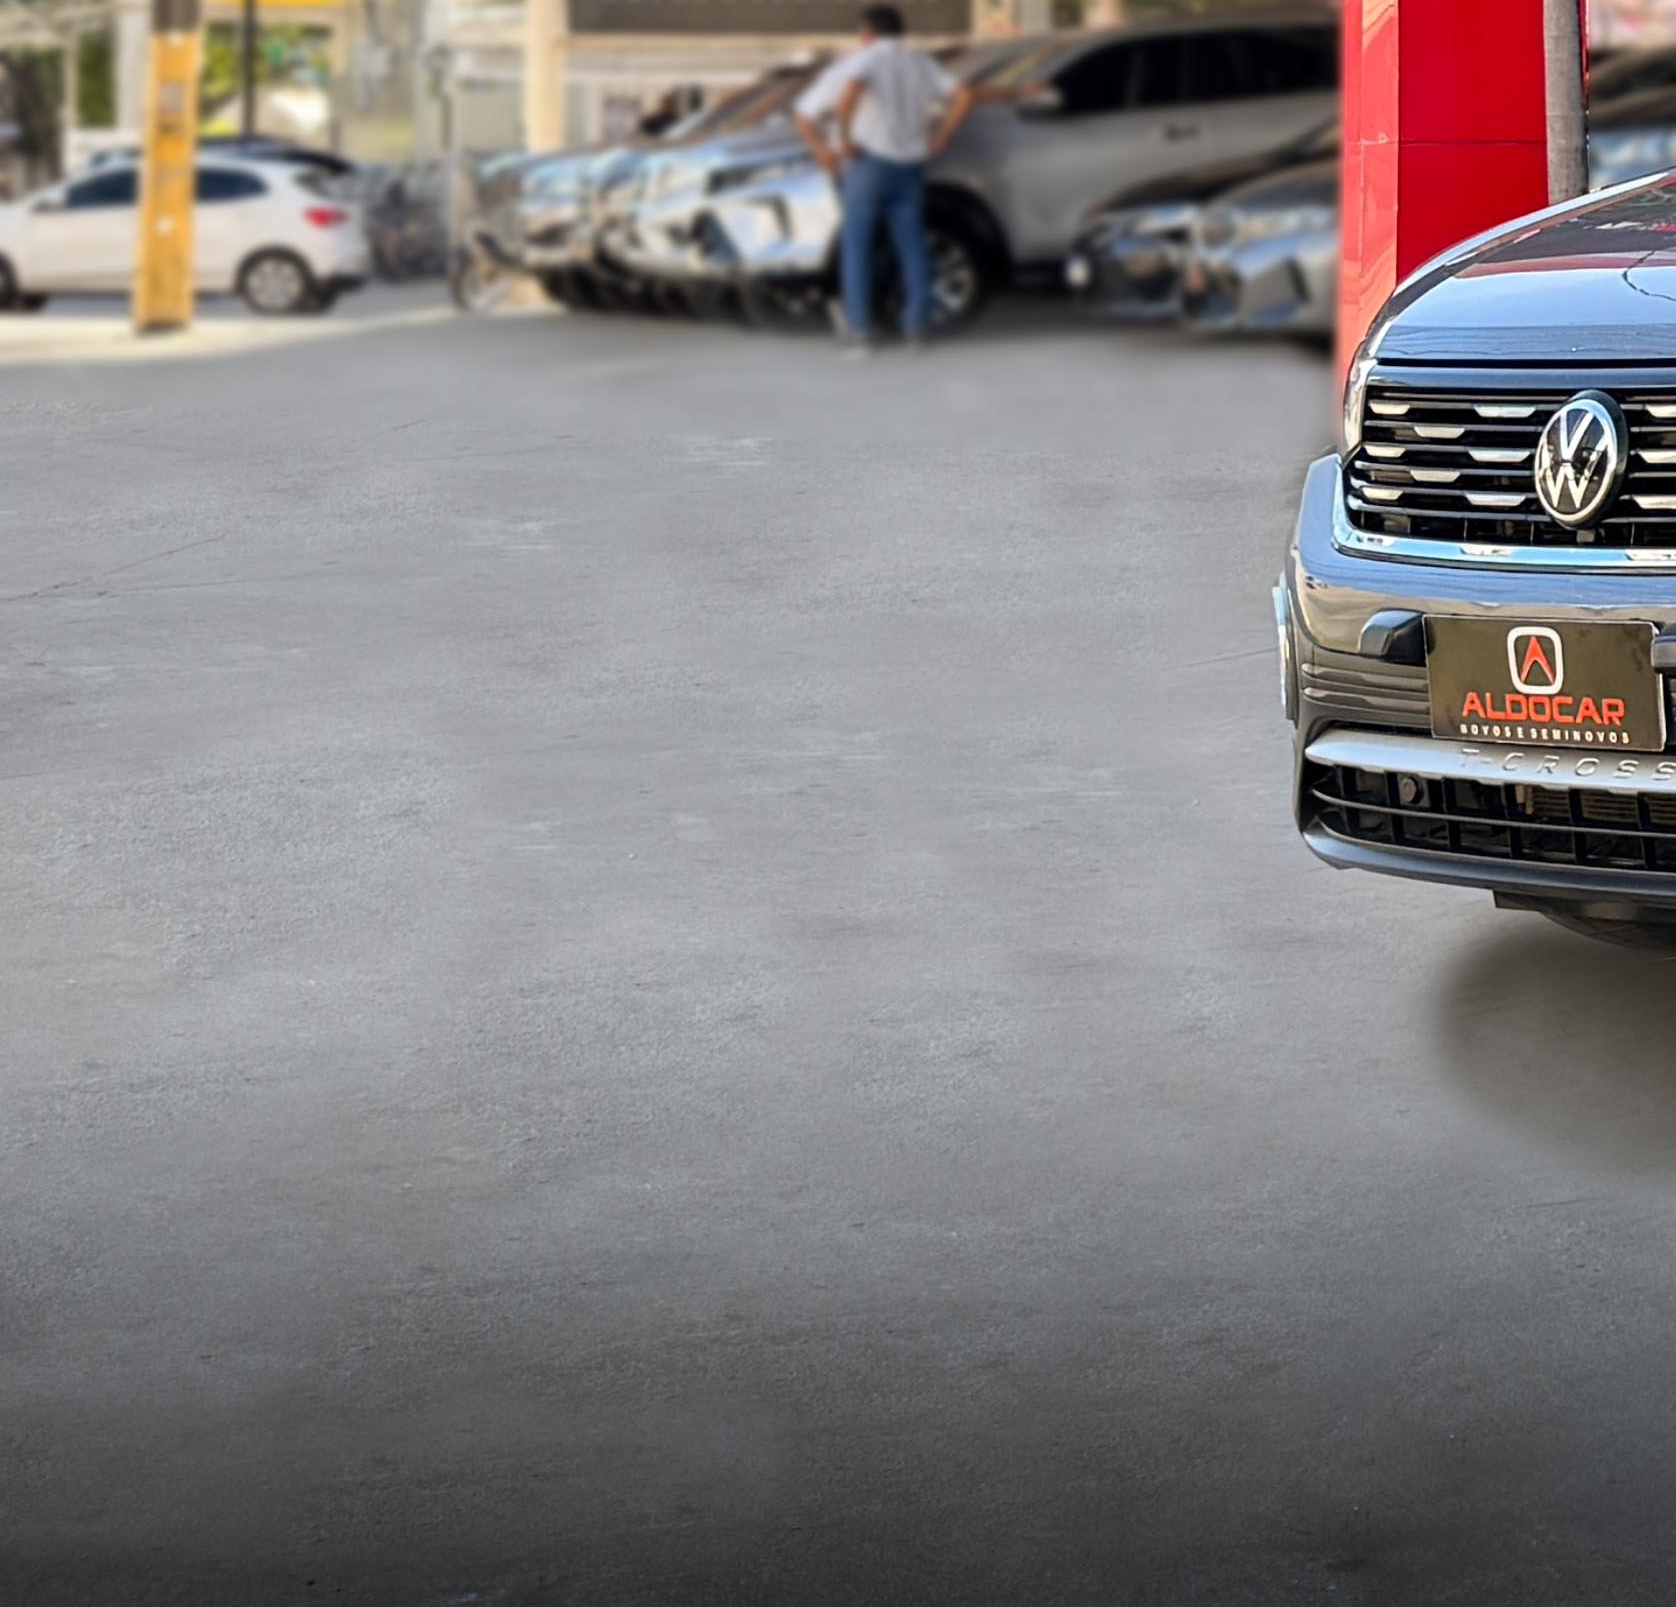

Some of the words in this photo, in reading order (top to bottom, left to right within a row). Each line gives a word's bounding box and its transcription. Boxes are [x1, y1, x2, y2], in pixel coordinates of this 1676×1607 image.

[1462, 692, 1625, 727] ALDOCAR
[1460, 723, 1511, 738] NOVOS
[1516, 726, 1525, 739] E
[1530, 728, 1630, 744] SEMINOVOS
